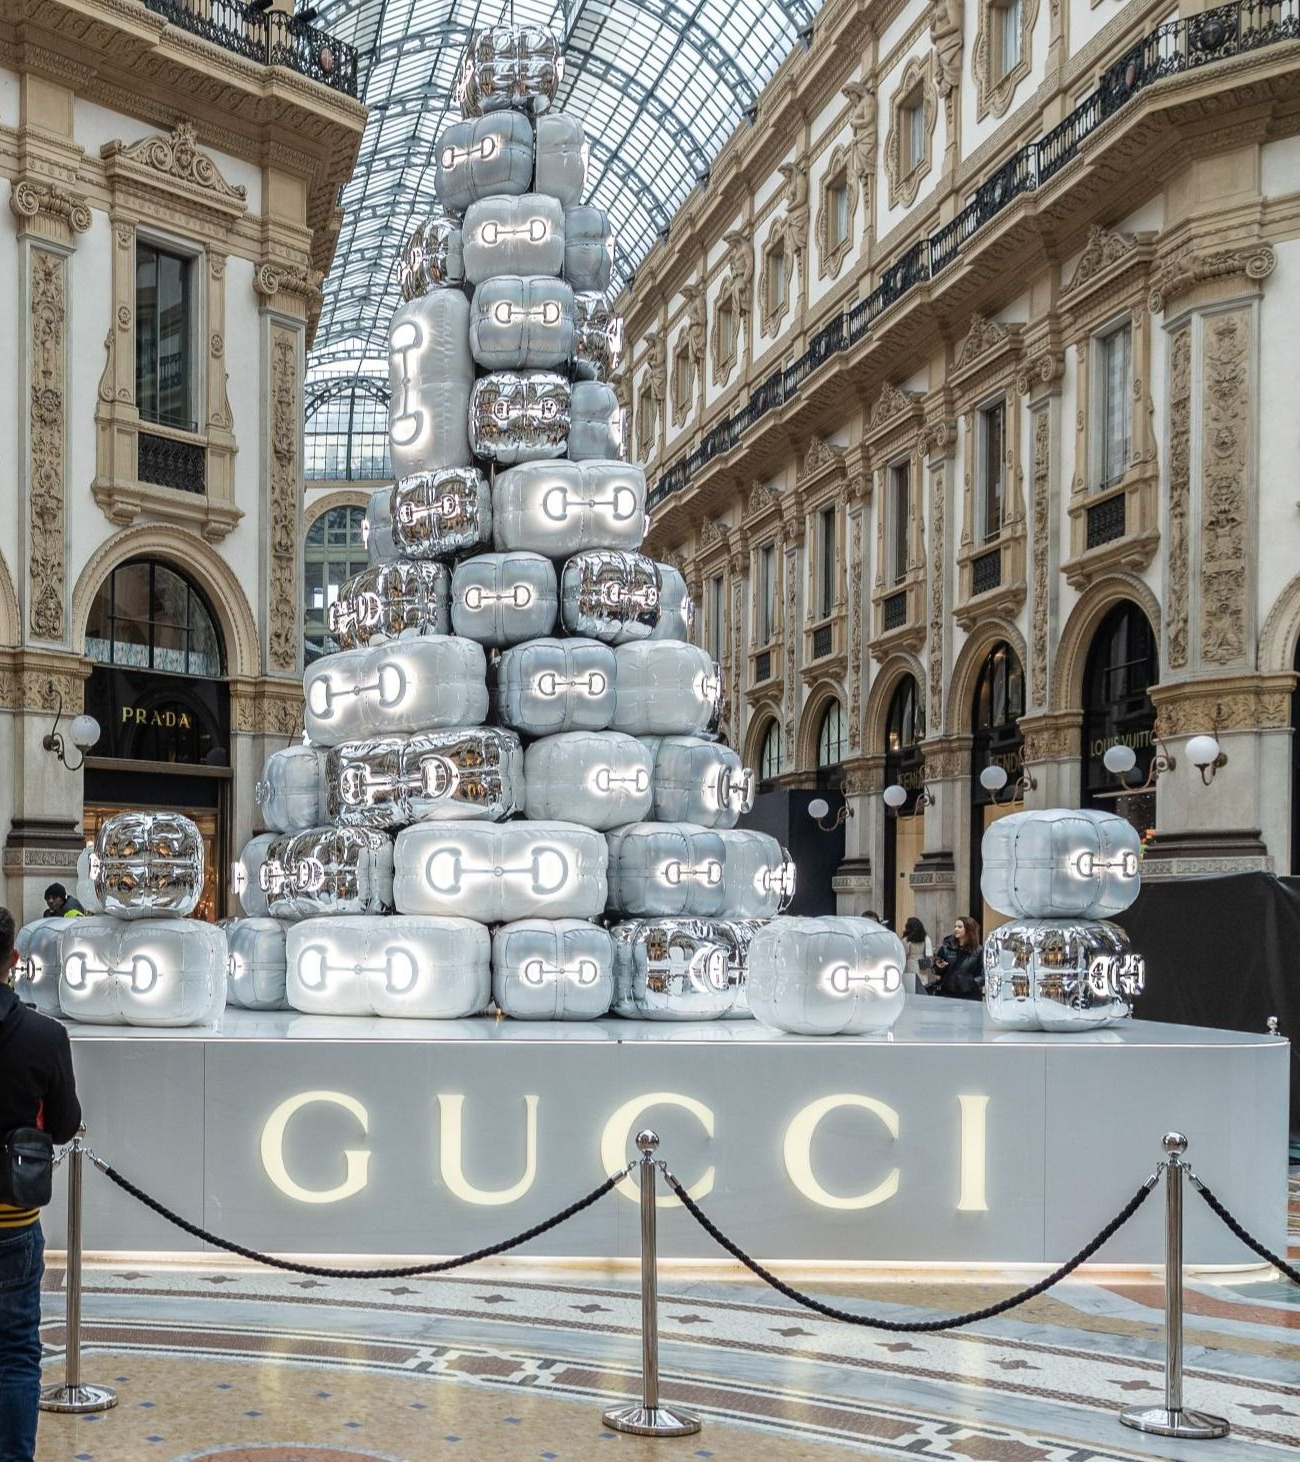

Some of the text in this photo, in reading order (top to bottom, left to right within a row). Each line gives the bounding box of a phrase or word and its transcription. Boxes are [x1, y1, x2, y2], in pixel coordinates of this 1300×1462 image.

[122, 706, 190, 728] PRADA
[1121, 730, 1157, 749] VUITTO
[260, 1090, 991, 1212] GUCCI
